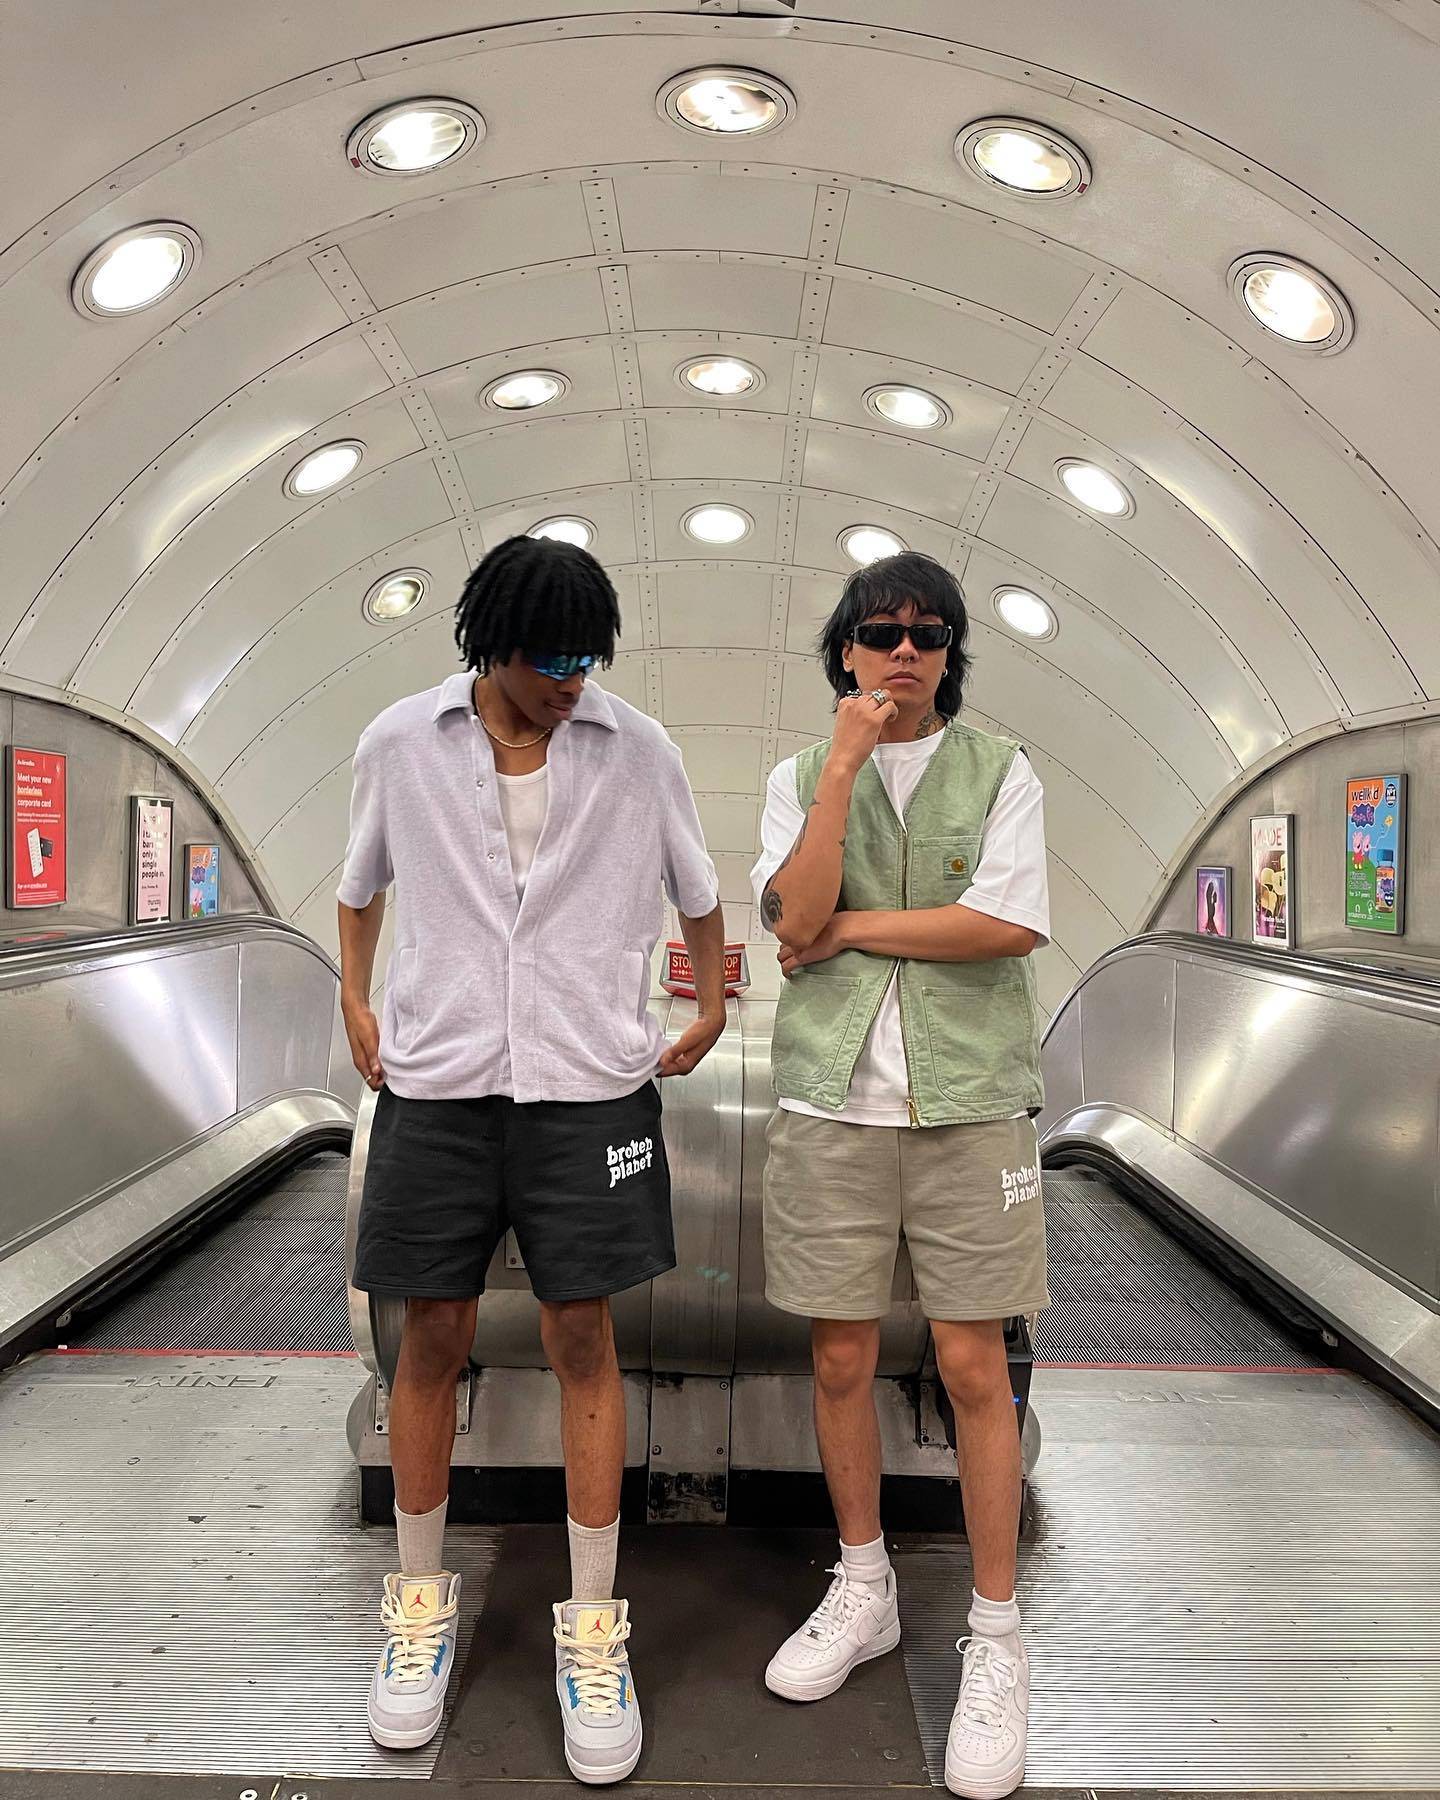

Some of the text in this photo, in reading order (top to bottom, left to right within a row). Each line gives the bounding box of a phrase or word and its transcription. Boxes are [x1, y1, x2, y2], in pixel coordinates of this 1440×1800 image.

[17, 772, 52, 784] Meet your new
[17, 799, 52, 808] corporate card
[142, 871, 159, 880] people
[724, 956, 738, 969] OP
[606, 1136, 653, 1166] broken
[609, 1151, 653, 1189] planet
